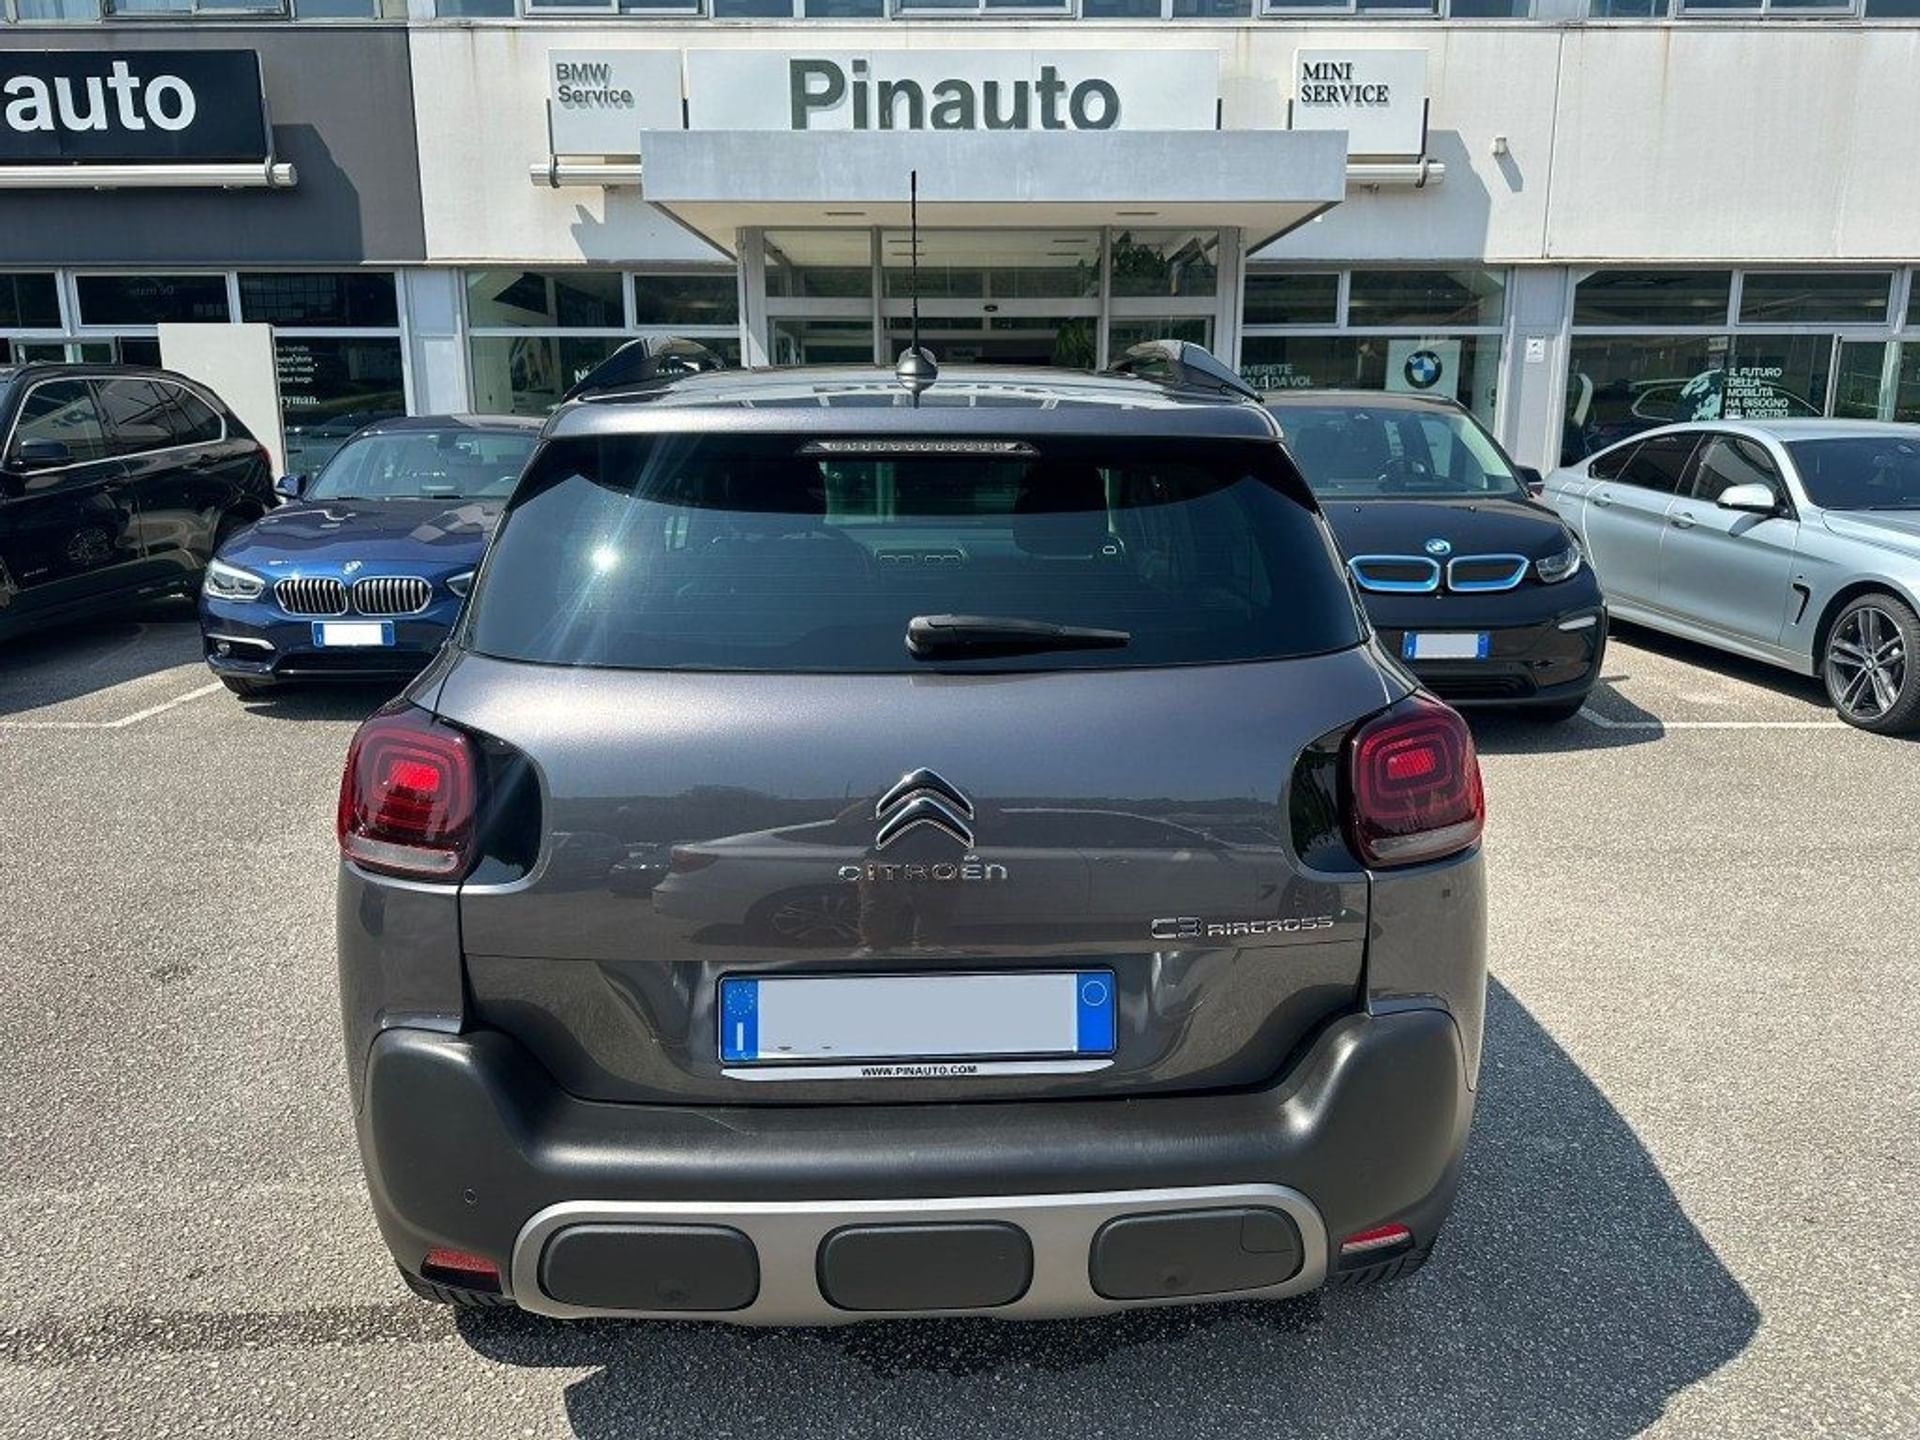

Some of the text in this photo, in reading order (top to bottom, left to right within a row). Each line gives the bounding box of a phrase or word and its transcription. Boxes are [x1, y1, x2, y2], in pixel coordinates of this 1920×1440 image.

[556, 63, 608, 81] BMW
[1303, 62, 1353, 80] MINI
[3, 60, 196, 132] auto
[558, 85, 633, 103] Service
[789, 59, 1120, 130] Pinauto
[1301, 84, 1388, 103] SERVICE
[1729, 367, 1782, 377] IL FUTURO
[1728, 377, 1760, 387] DELLA
[280, 396, 320, 408] ryman.
[1725, 398, 1789, 408] HA BISOGNO
[1746, 408, 1788, 418] NOSTRO
[1151, 915, 1334, 939] C3 AIRCROSS
[860, 1065, 978, 1077] WWW.PINAUTO.COM
